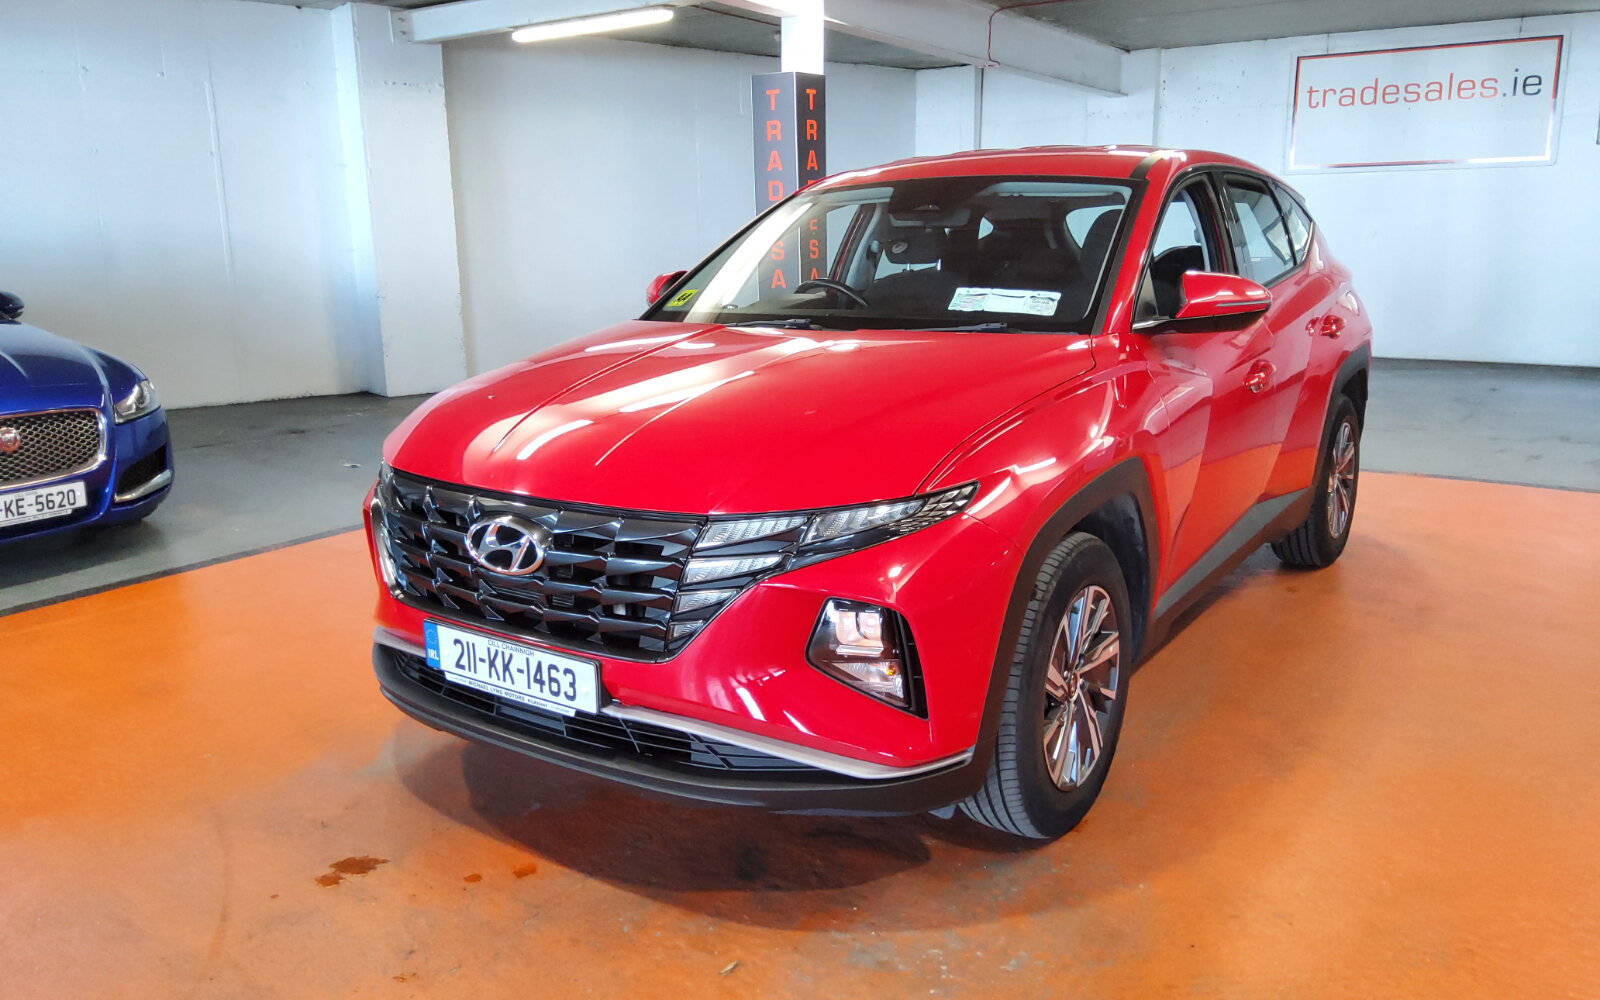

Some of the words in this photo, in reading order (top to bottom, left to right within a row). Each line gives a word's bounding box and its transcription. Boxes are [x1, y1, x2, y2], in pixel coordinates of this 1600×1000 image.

[1307, 68, 1543, 109] tradesales.ie
[765, 88, 787, 289] TRADSA
[427, 648, 440, 661] IRL
[453, 637, 577, 702] 211-KK-1463
[468, 680, 489, 691] MICHAEL
[504, 691, 525, 702] MOTORS
